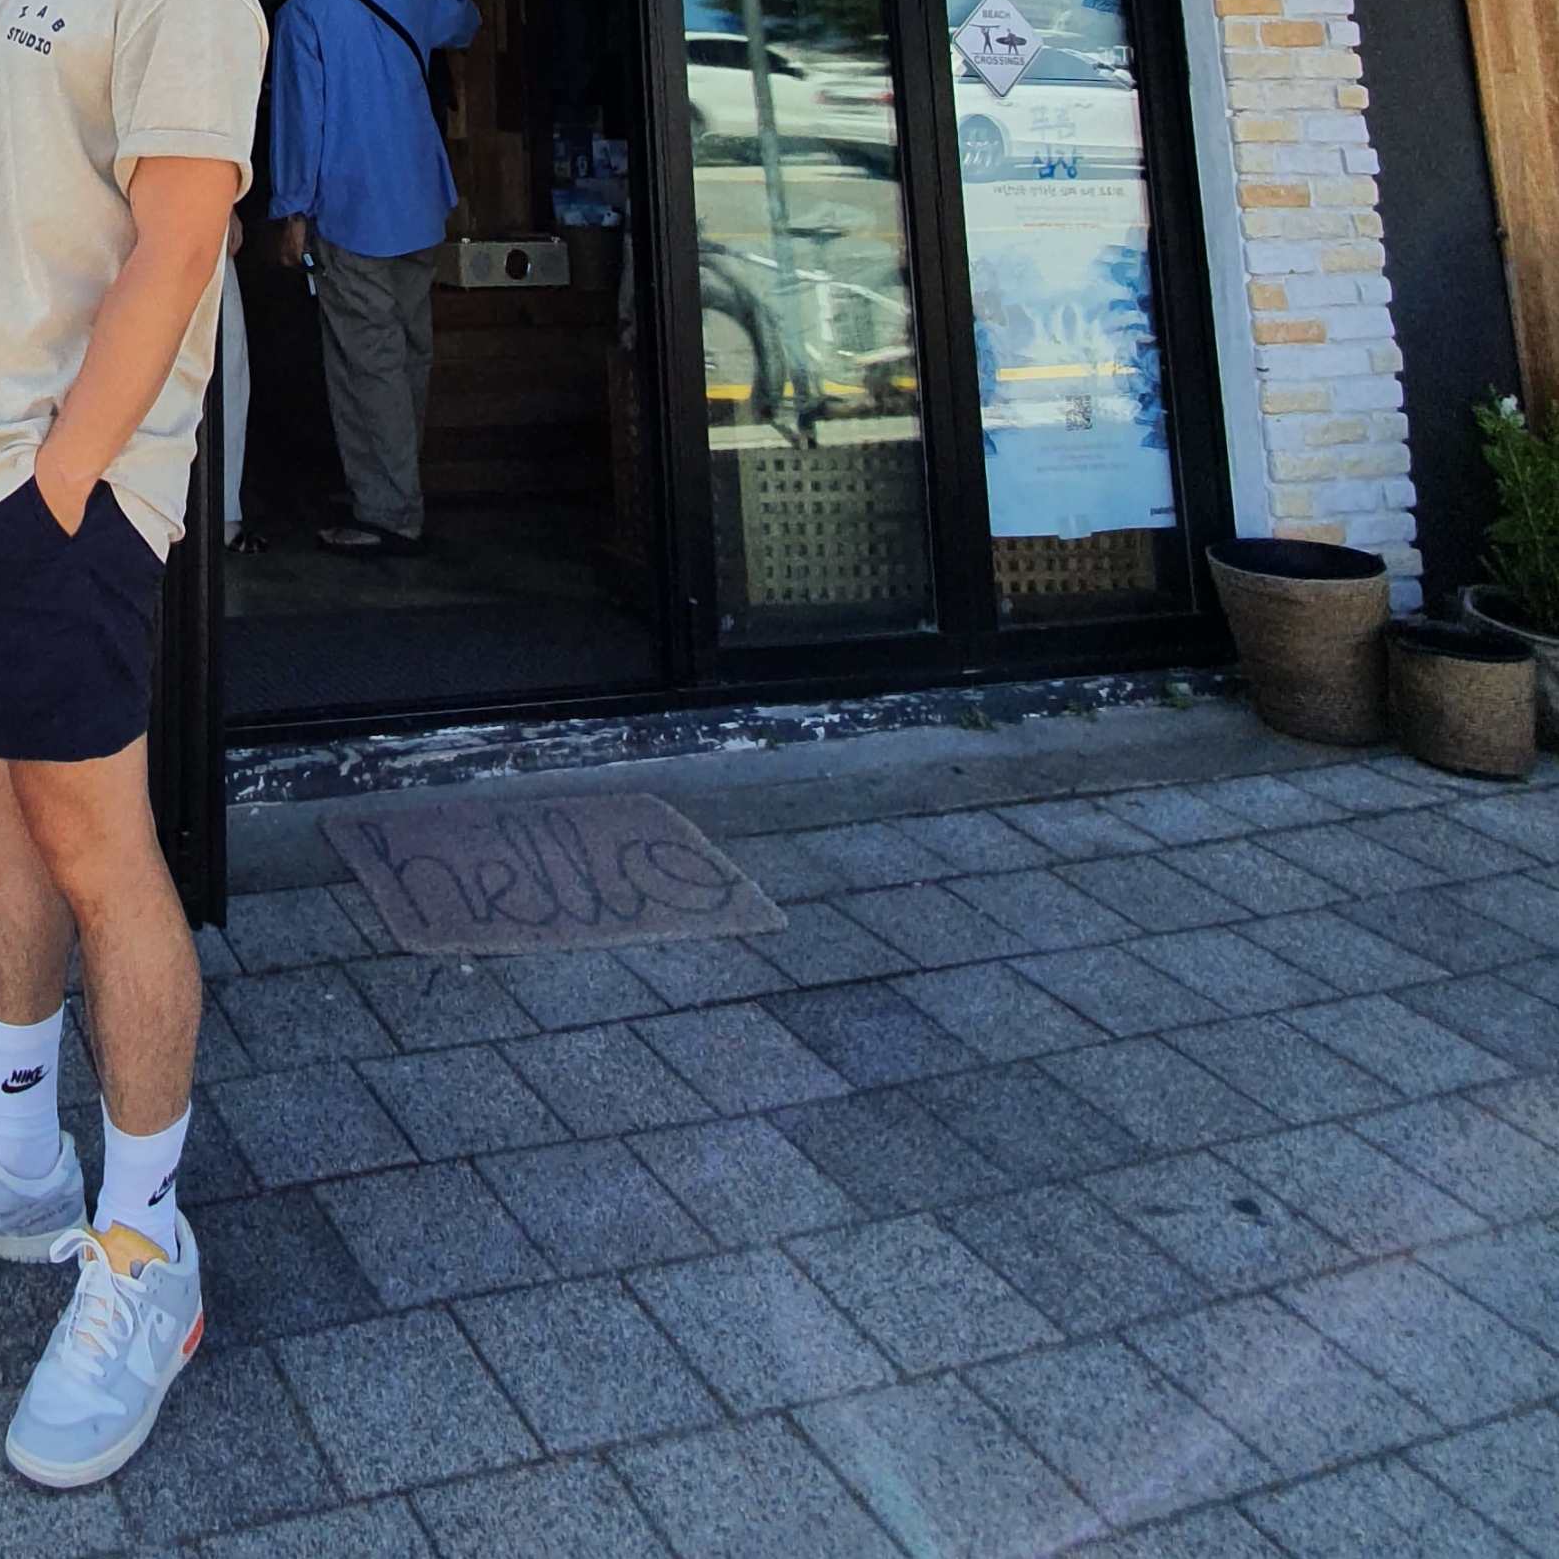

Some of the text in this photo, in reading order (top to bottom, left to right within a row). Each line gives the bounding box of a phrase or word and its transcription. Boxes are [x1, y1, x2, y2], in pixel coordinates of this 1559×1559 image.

[982, 9, 1011, 19] BEACH
[6, 26, 52, 56] STUDIO
[973, 55, 1026, 66] CROSSINGS
[1032, 143, 1084, 179] 심장
[357, 807, 743, 928] hello
[10, 1063, 44, 1084] NIKE
